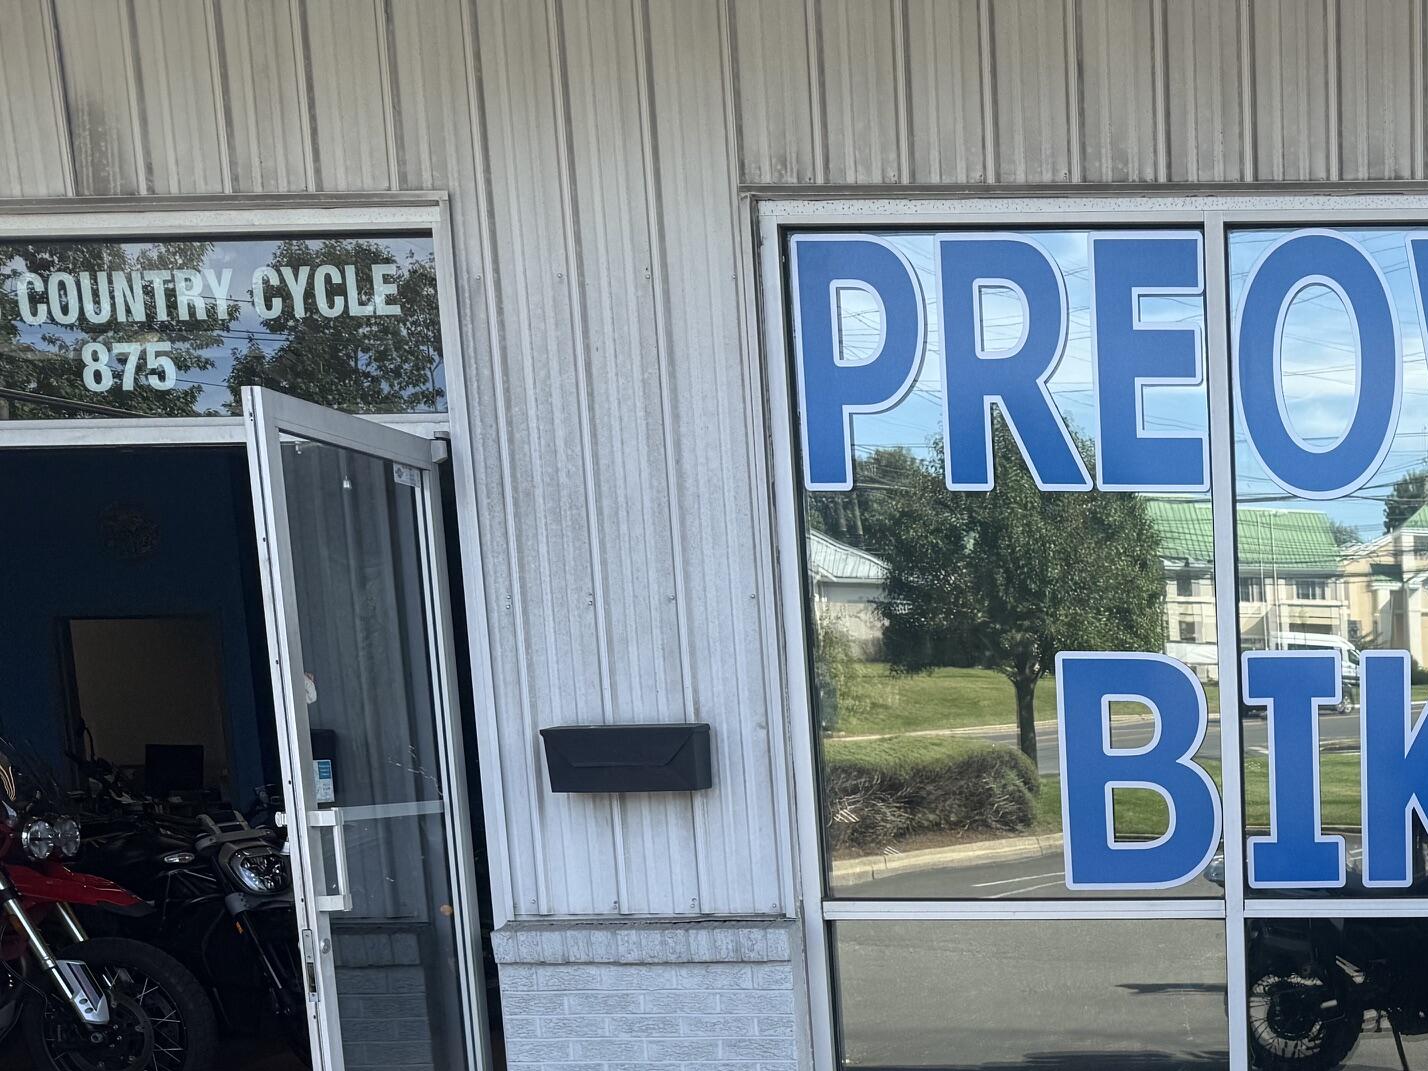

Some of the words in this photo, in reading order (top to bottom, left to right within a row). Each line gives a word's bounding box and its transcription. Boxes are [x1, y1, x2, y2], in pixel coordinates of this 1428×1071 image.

[15, 267, 233, 326] COUNTRY
[252, 263, 402, 321] CYCLE
[81, 341, 177, 393] 875
